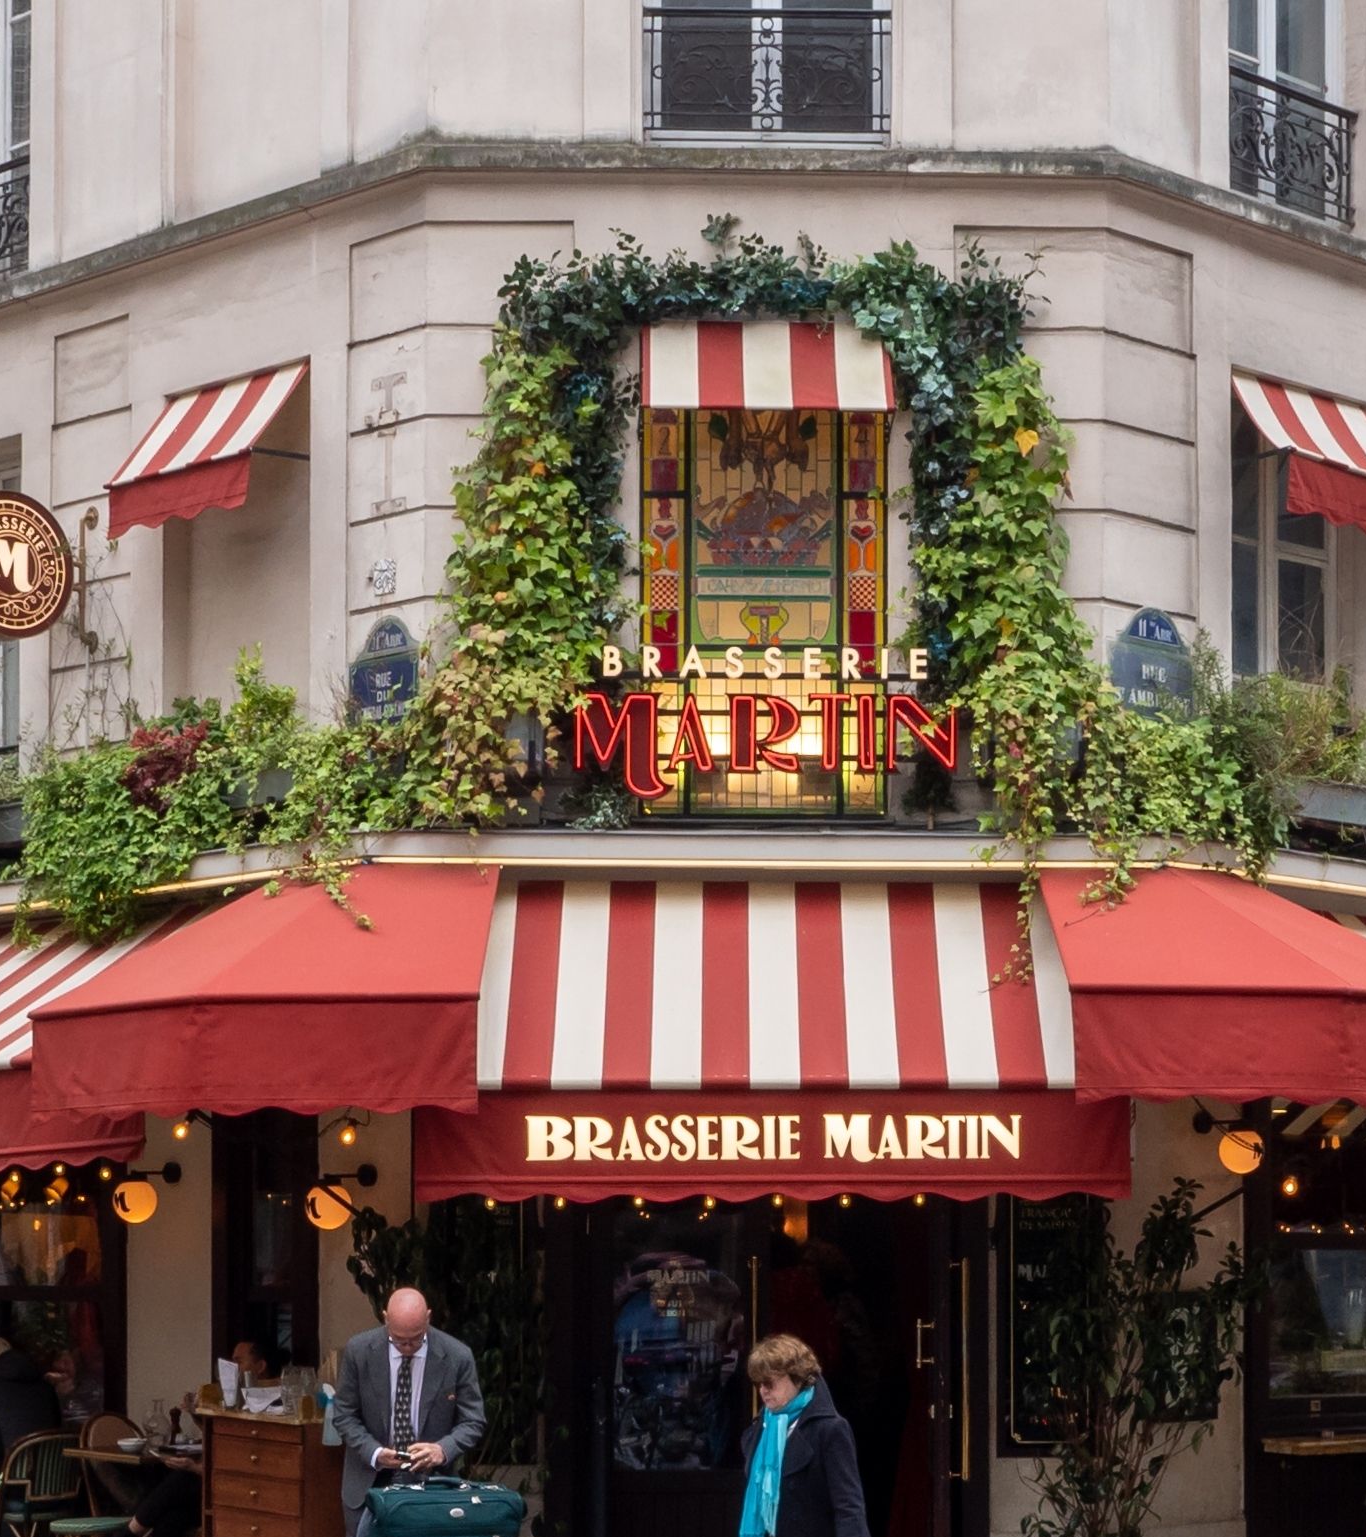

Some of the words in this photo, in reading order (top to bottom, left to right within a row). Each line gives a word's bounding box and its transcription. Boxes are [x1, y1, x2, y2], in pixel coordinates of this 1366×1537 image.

[375, 671, 392, 689] RUE
[602, 646, 929, 679] BRASSERIE
[573, 692, 958, 799] MARTIN
[525, 1114, 800, 1162] BRASSERIE
[823, 1113, 1021, 1164] MARTIN
